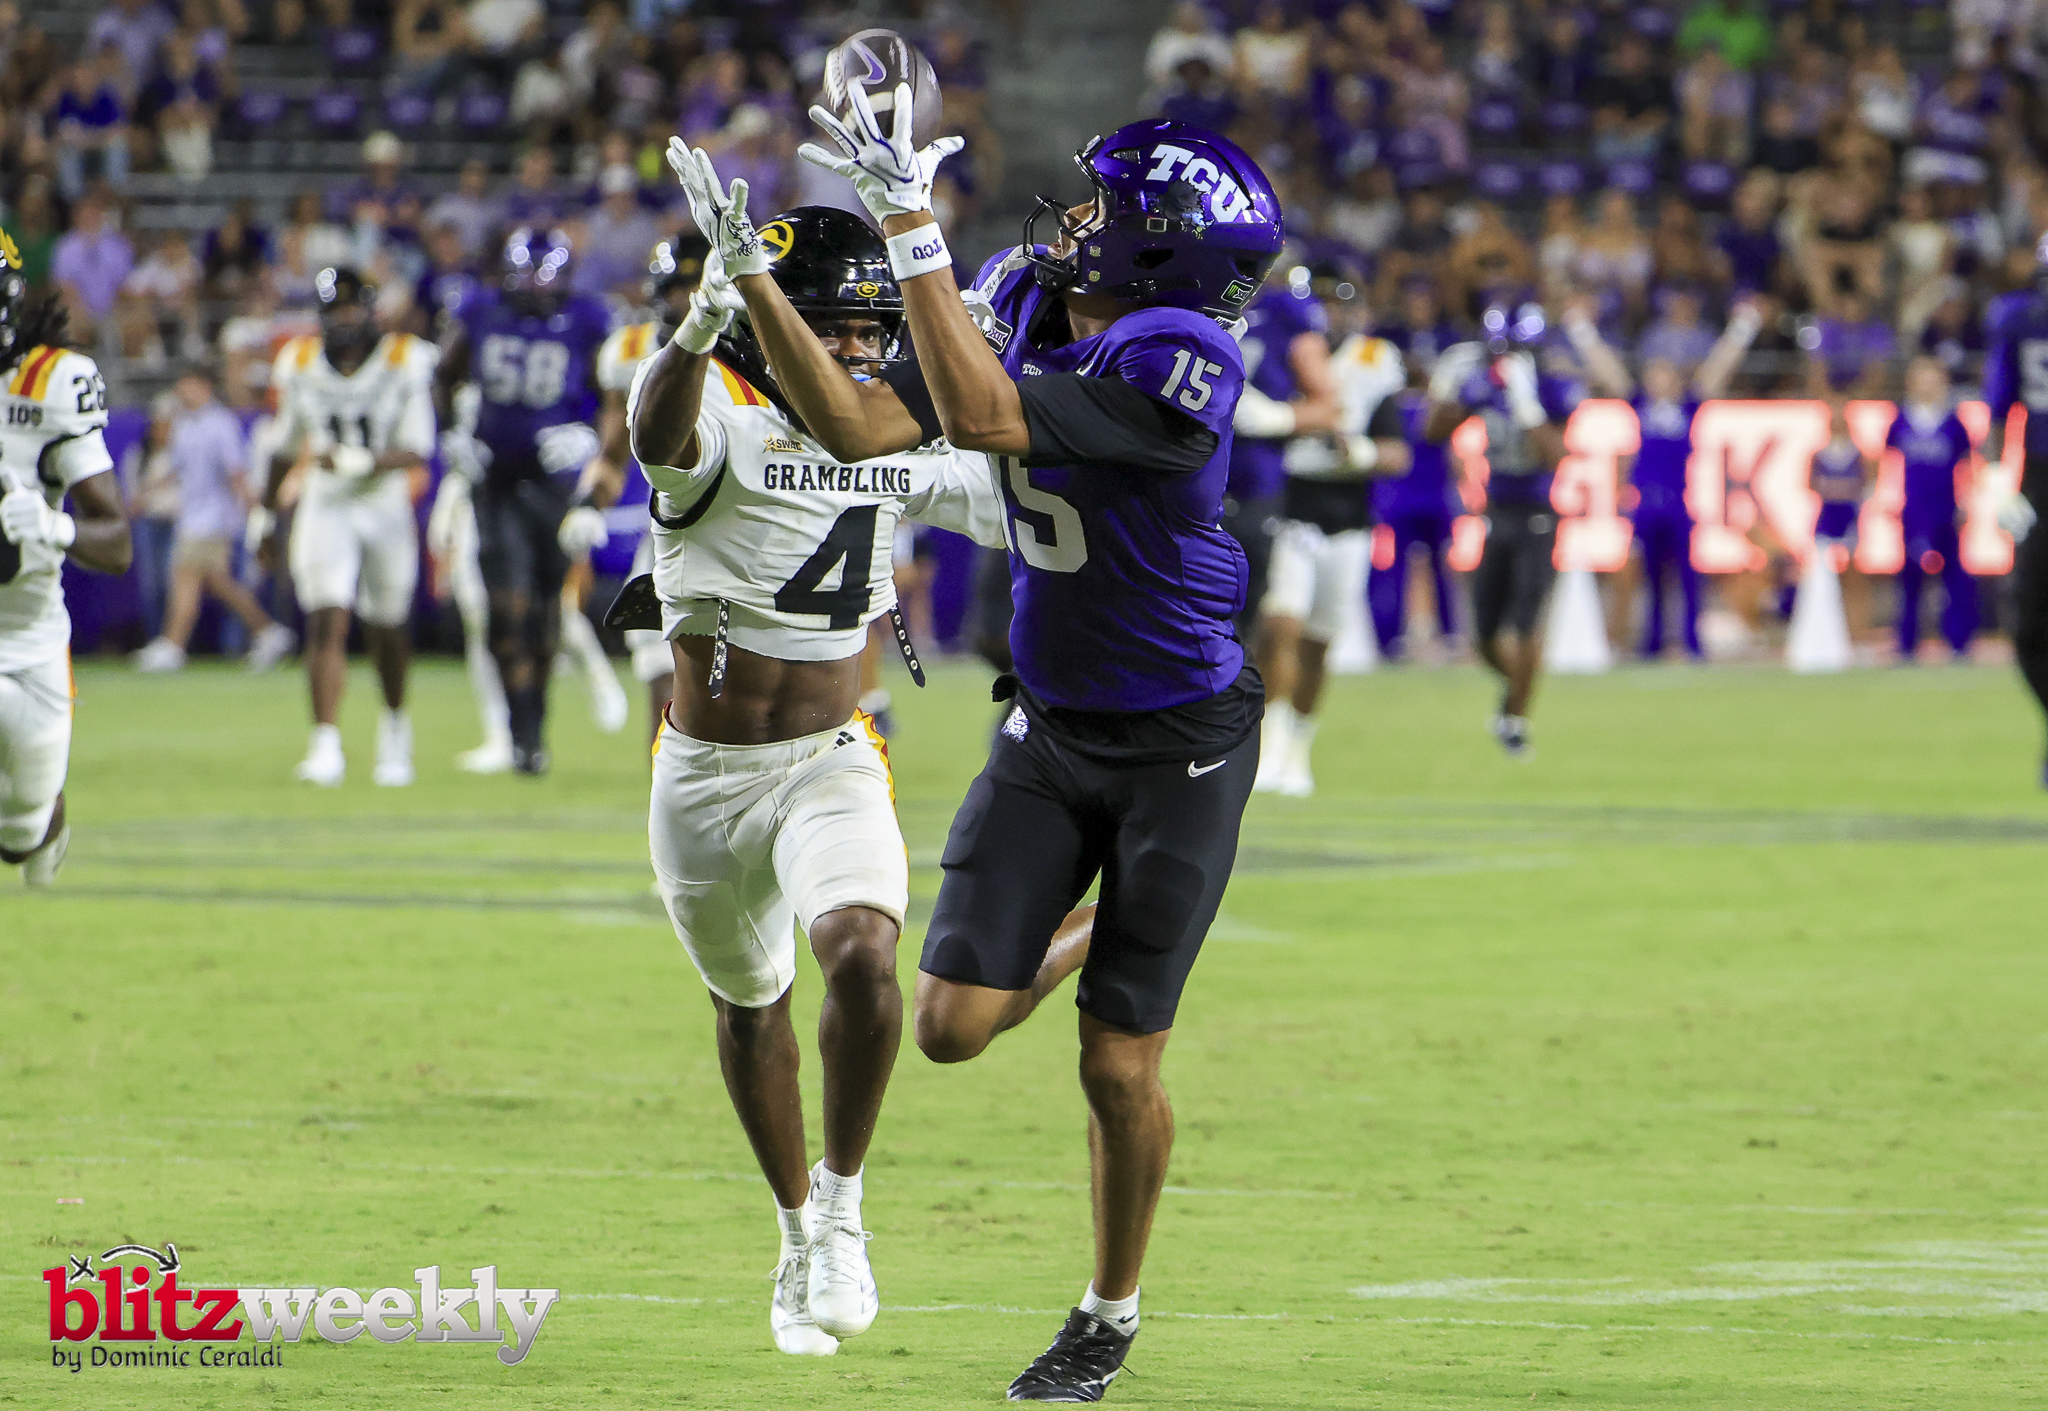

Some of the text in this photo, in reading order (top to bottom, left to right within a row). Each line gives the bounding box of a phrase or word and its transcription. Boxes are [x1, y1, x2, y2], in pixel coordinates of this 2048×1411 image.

[1146, 143, 1250, 223] TCU
[912, 238, 943, 260] TCU
[482, 333, 571, 408] 58
[1160, 349, 1224, 412] 15
[776, 438, 802, 451] SWAC
[764, 463, 911, 494] GRAMBLING
[774, 503, 881, 630] 4
